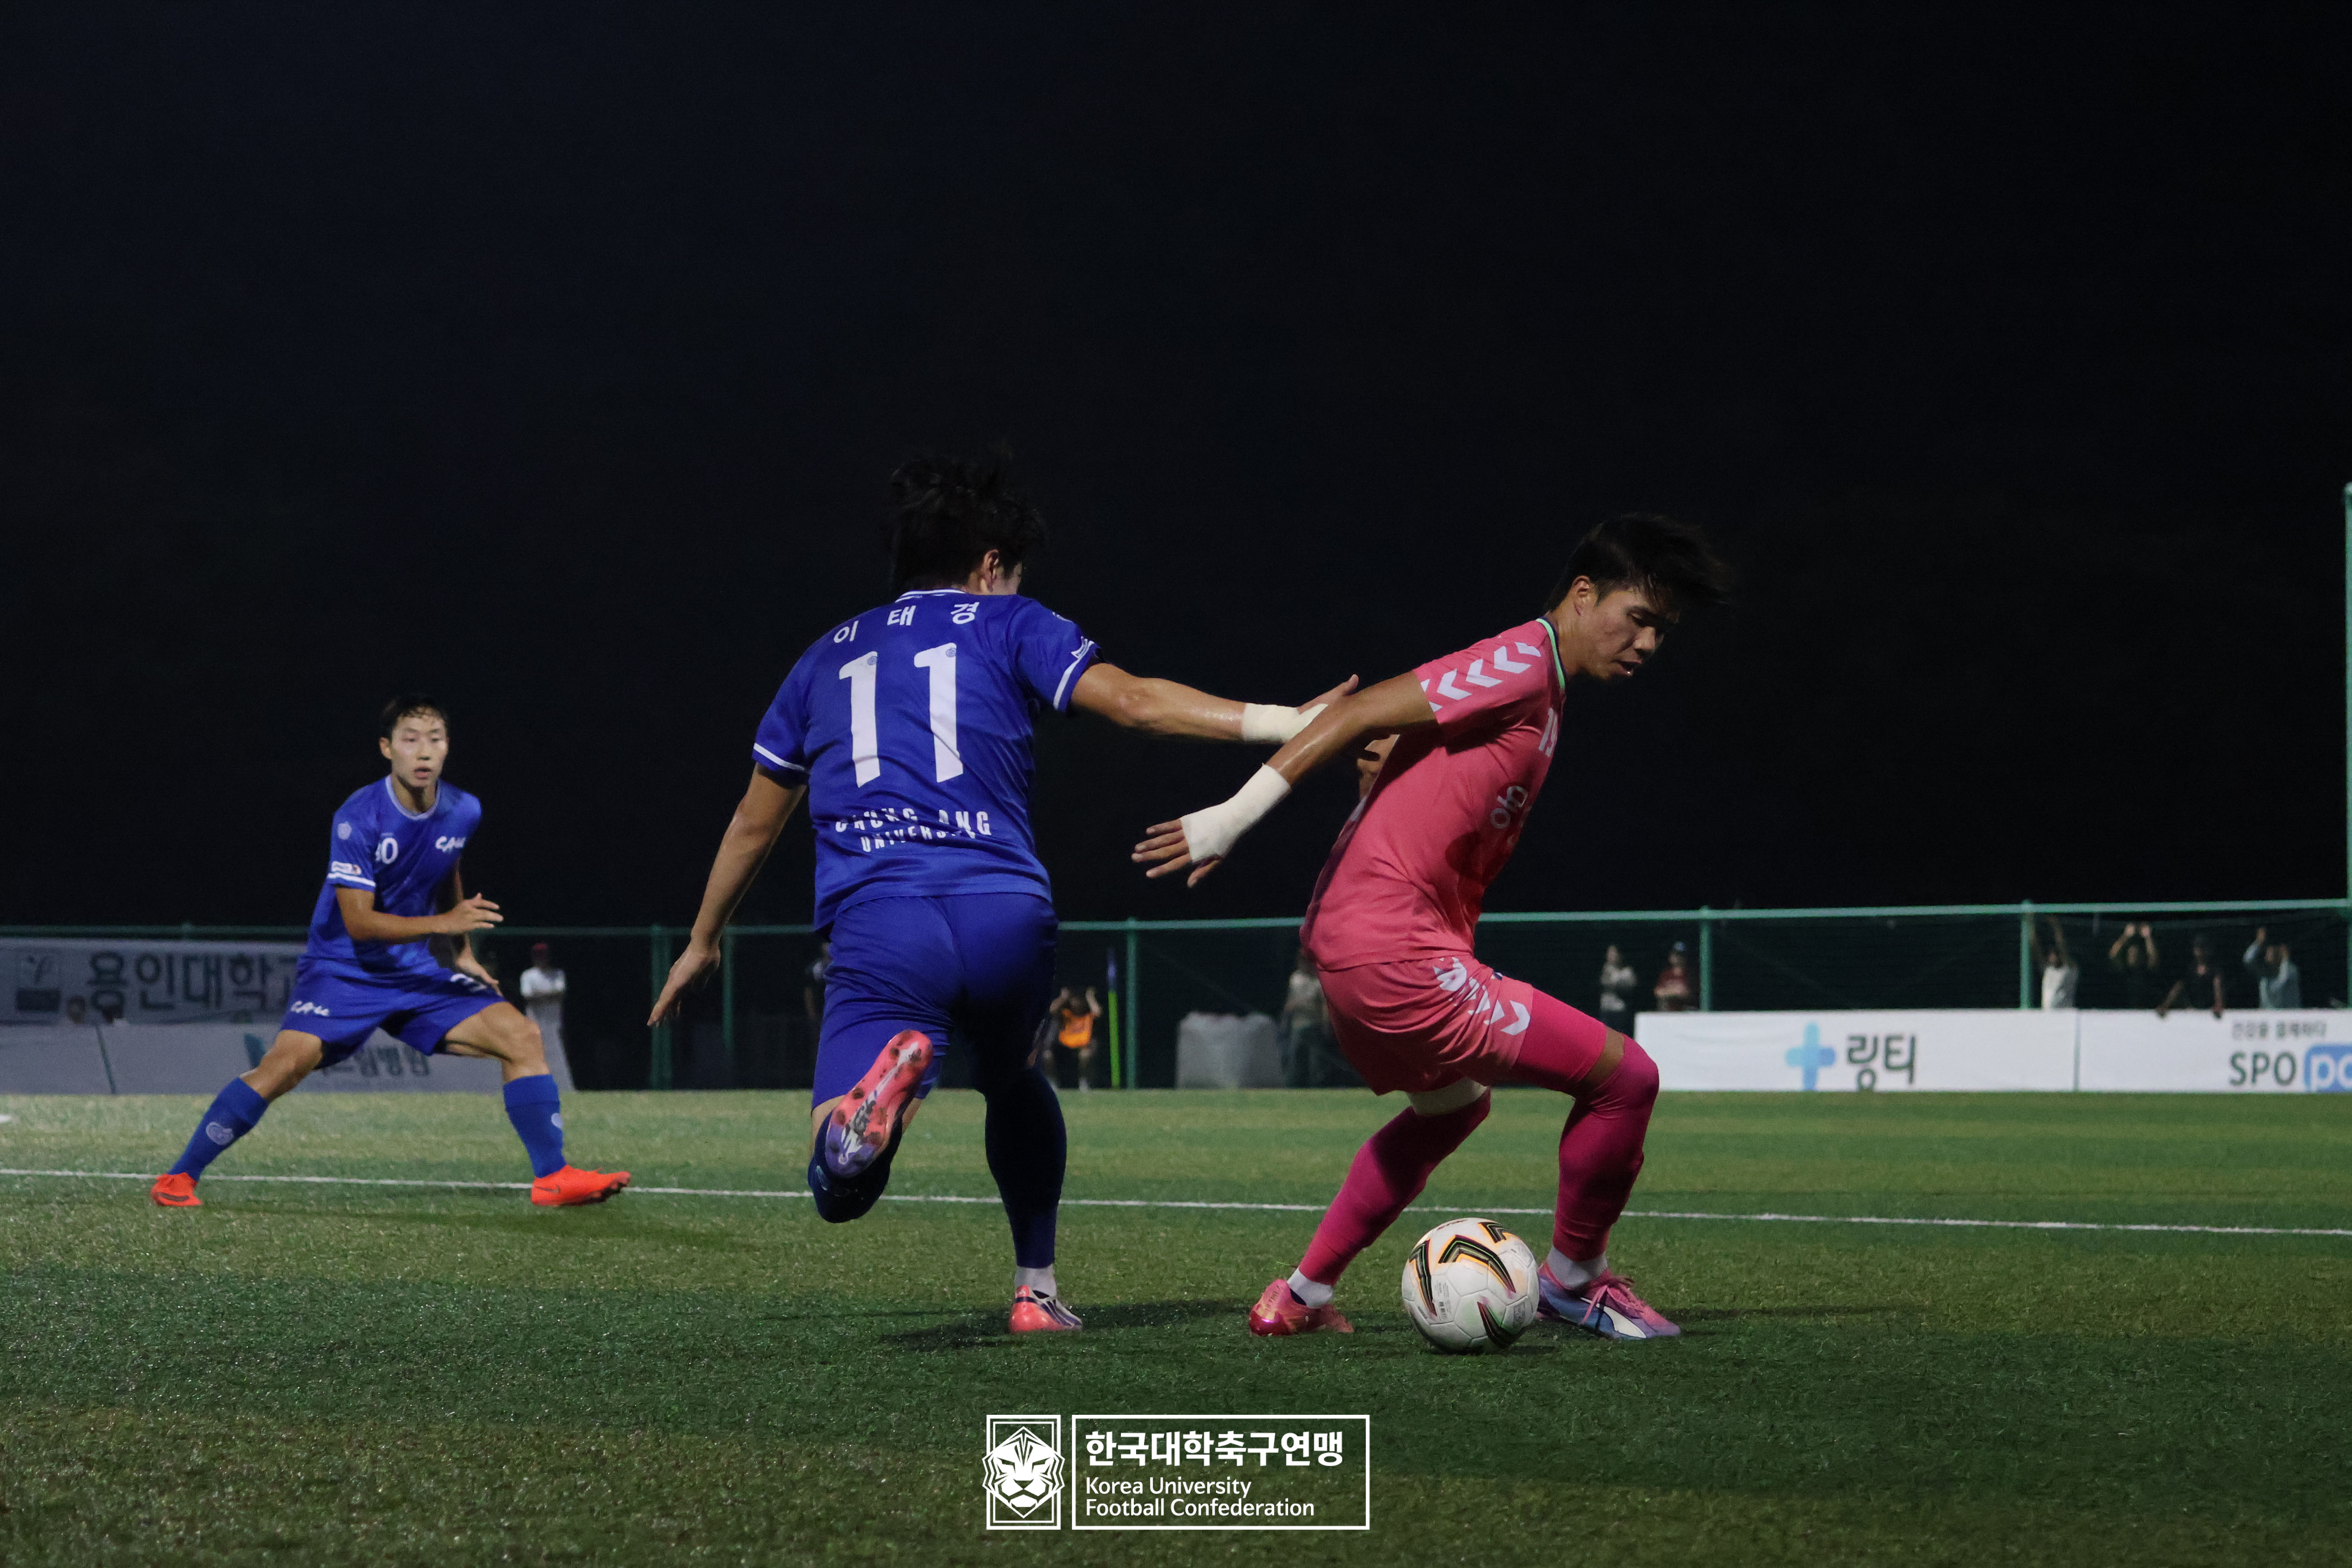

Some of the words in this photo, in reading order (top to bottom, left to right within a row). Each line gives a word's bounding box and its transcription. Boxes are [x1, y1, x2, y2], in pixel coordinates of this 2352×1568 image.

[838, 642, 964, 788] 11
[1847, 1034, 1916, 1091] 링티
[2229, 1051, 2297, 1086] SPO
